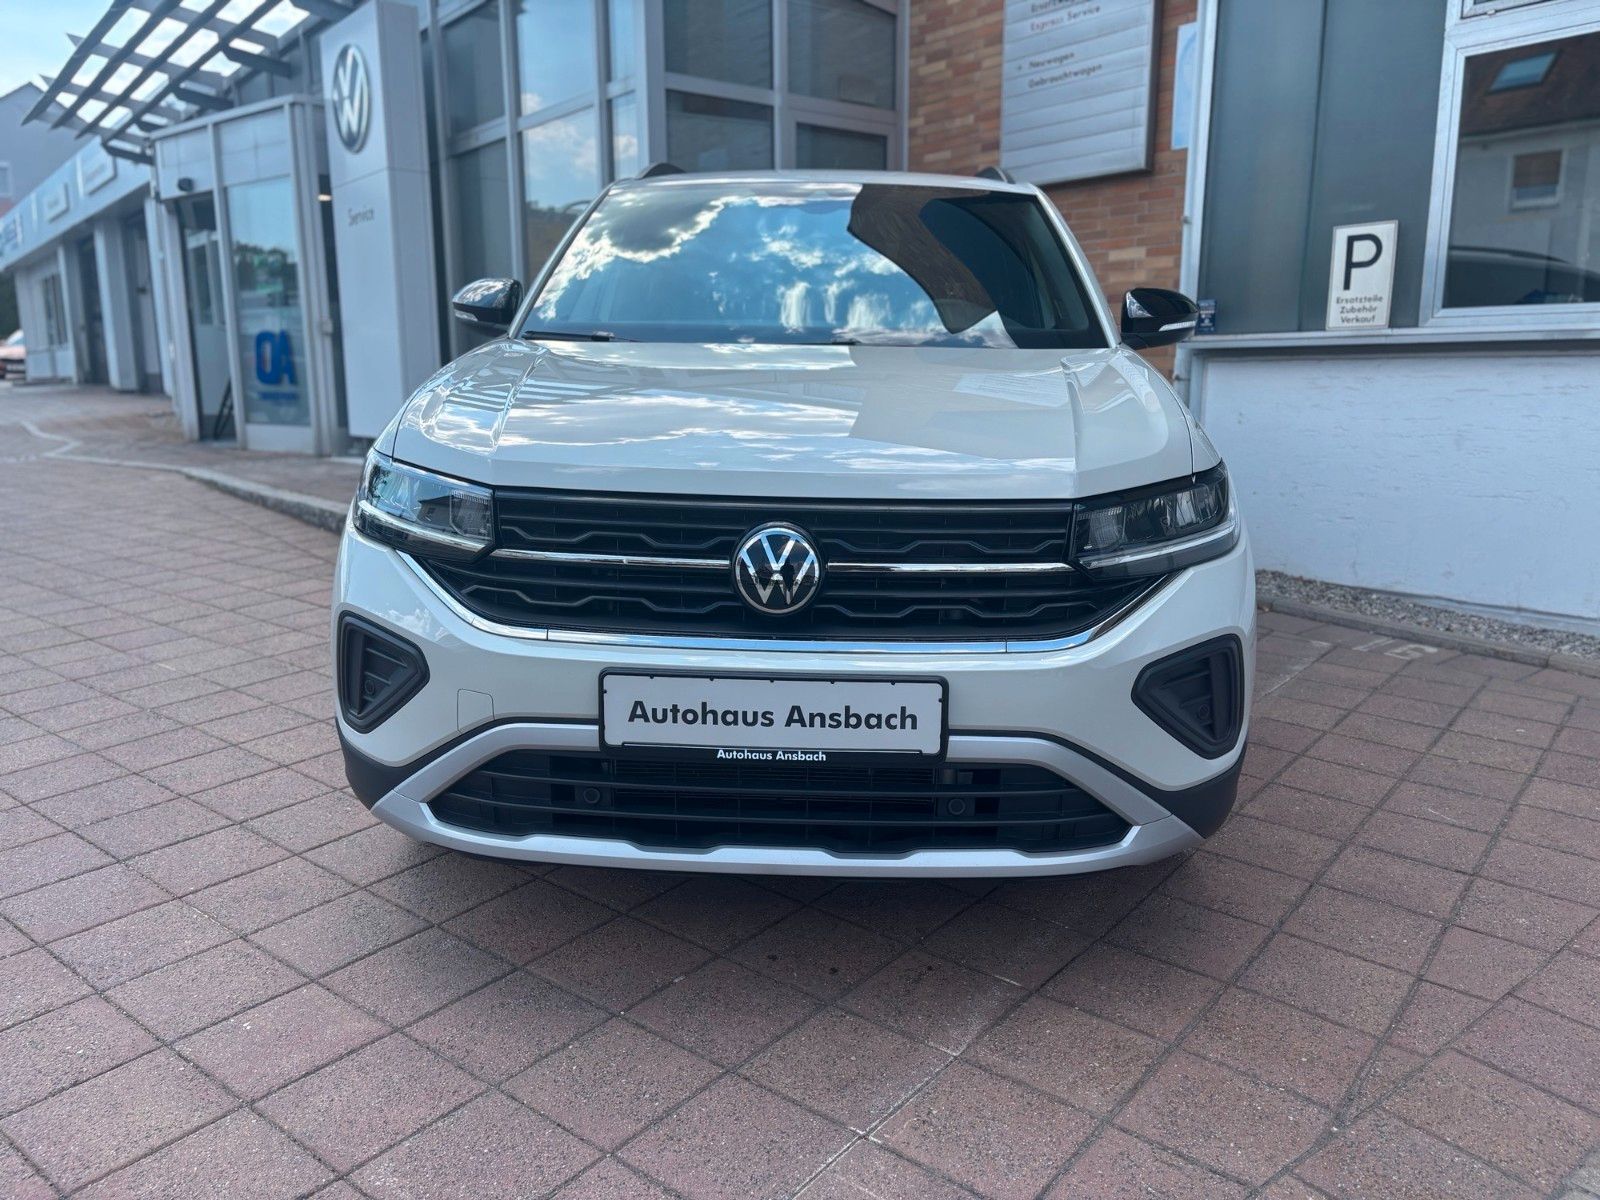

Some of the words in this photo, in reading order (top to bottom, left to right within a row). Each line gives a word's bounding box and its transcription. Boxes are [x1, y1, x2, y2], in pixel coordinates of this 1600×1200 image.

[1067, 5, 1100, 22] Service
[1029, 52, 1074, 69] Neuwagen
[1028, 63, 1102, 88] Gebrauchtwagen
[1343, 233, 1383, 291] P
[1336, 295, 1383, 304] Ersatzteile
[1340, 305, 1377, 314] Zubehör
[1340, 315, 1375, 323] Verkauf
[628, 700, 775, 727] Autohaus
[784, 704, 918, 730] Ansbach
[716, 749, 773, 761] Autohaus
[776, 749, 827, 762] Ansbach
